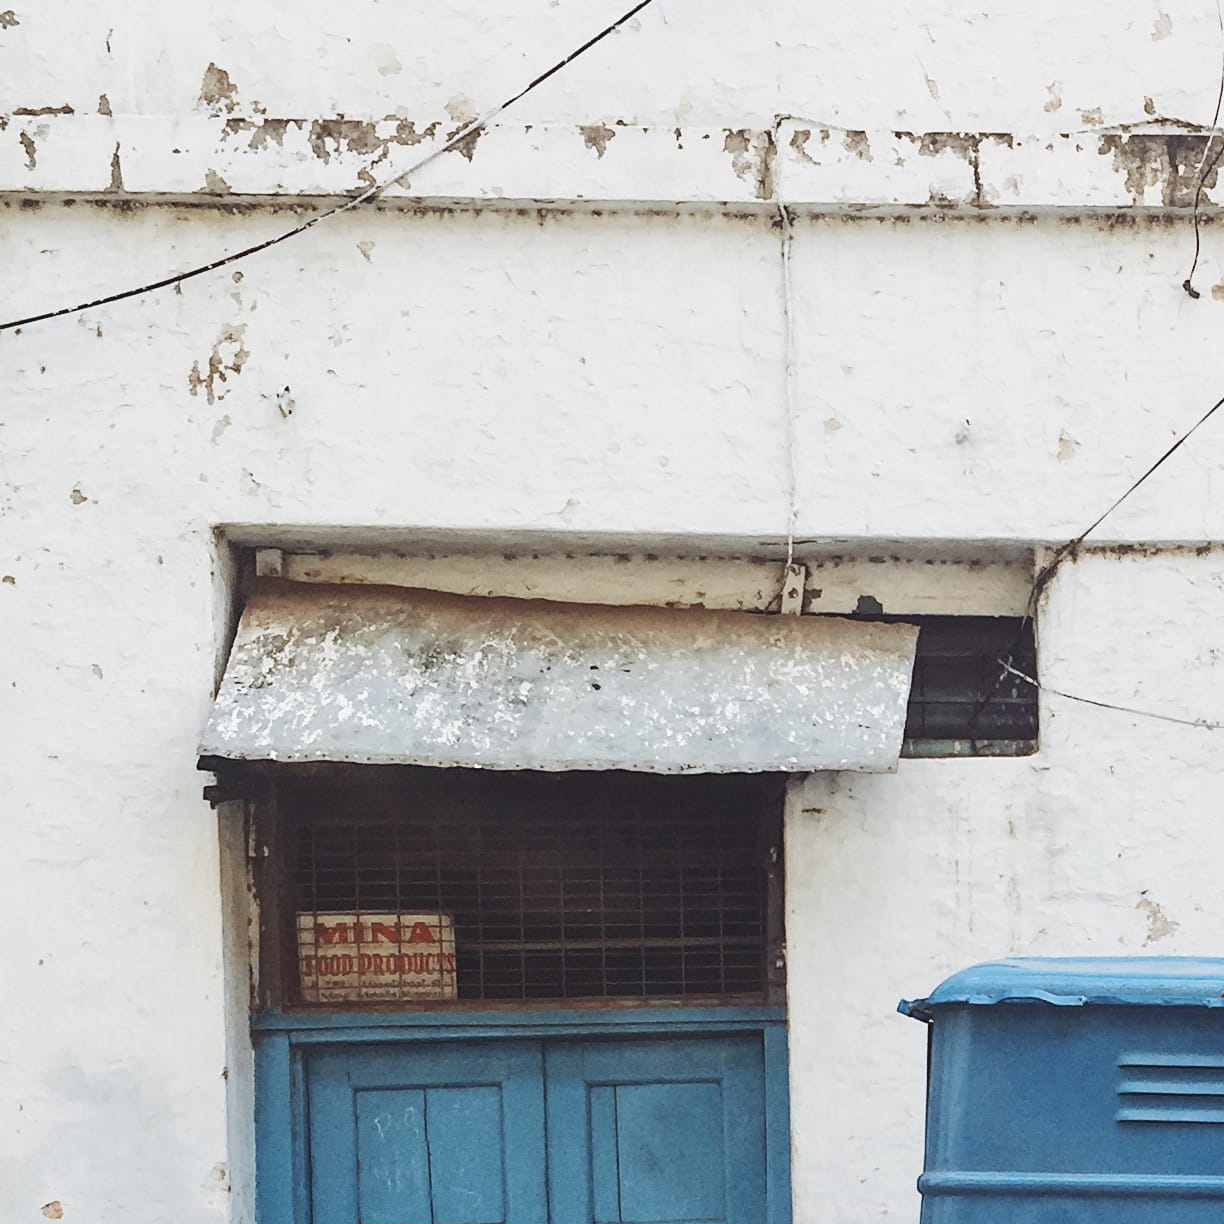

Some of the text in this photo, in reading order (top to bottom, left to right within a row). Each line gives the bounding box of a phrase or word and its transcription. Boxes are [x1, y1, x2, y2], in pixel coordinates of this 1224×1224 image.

[315, 922, 436, 944] MINA
[303, 952, 455, 977] FOOD PRODUCTS
